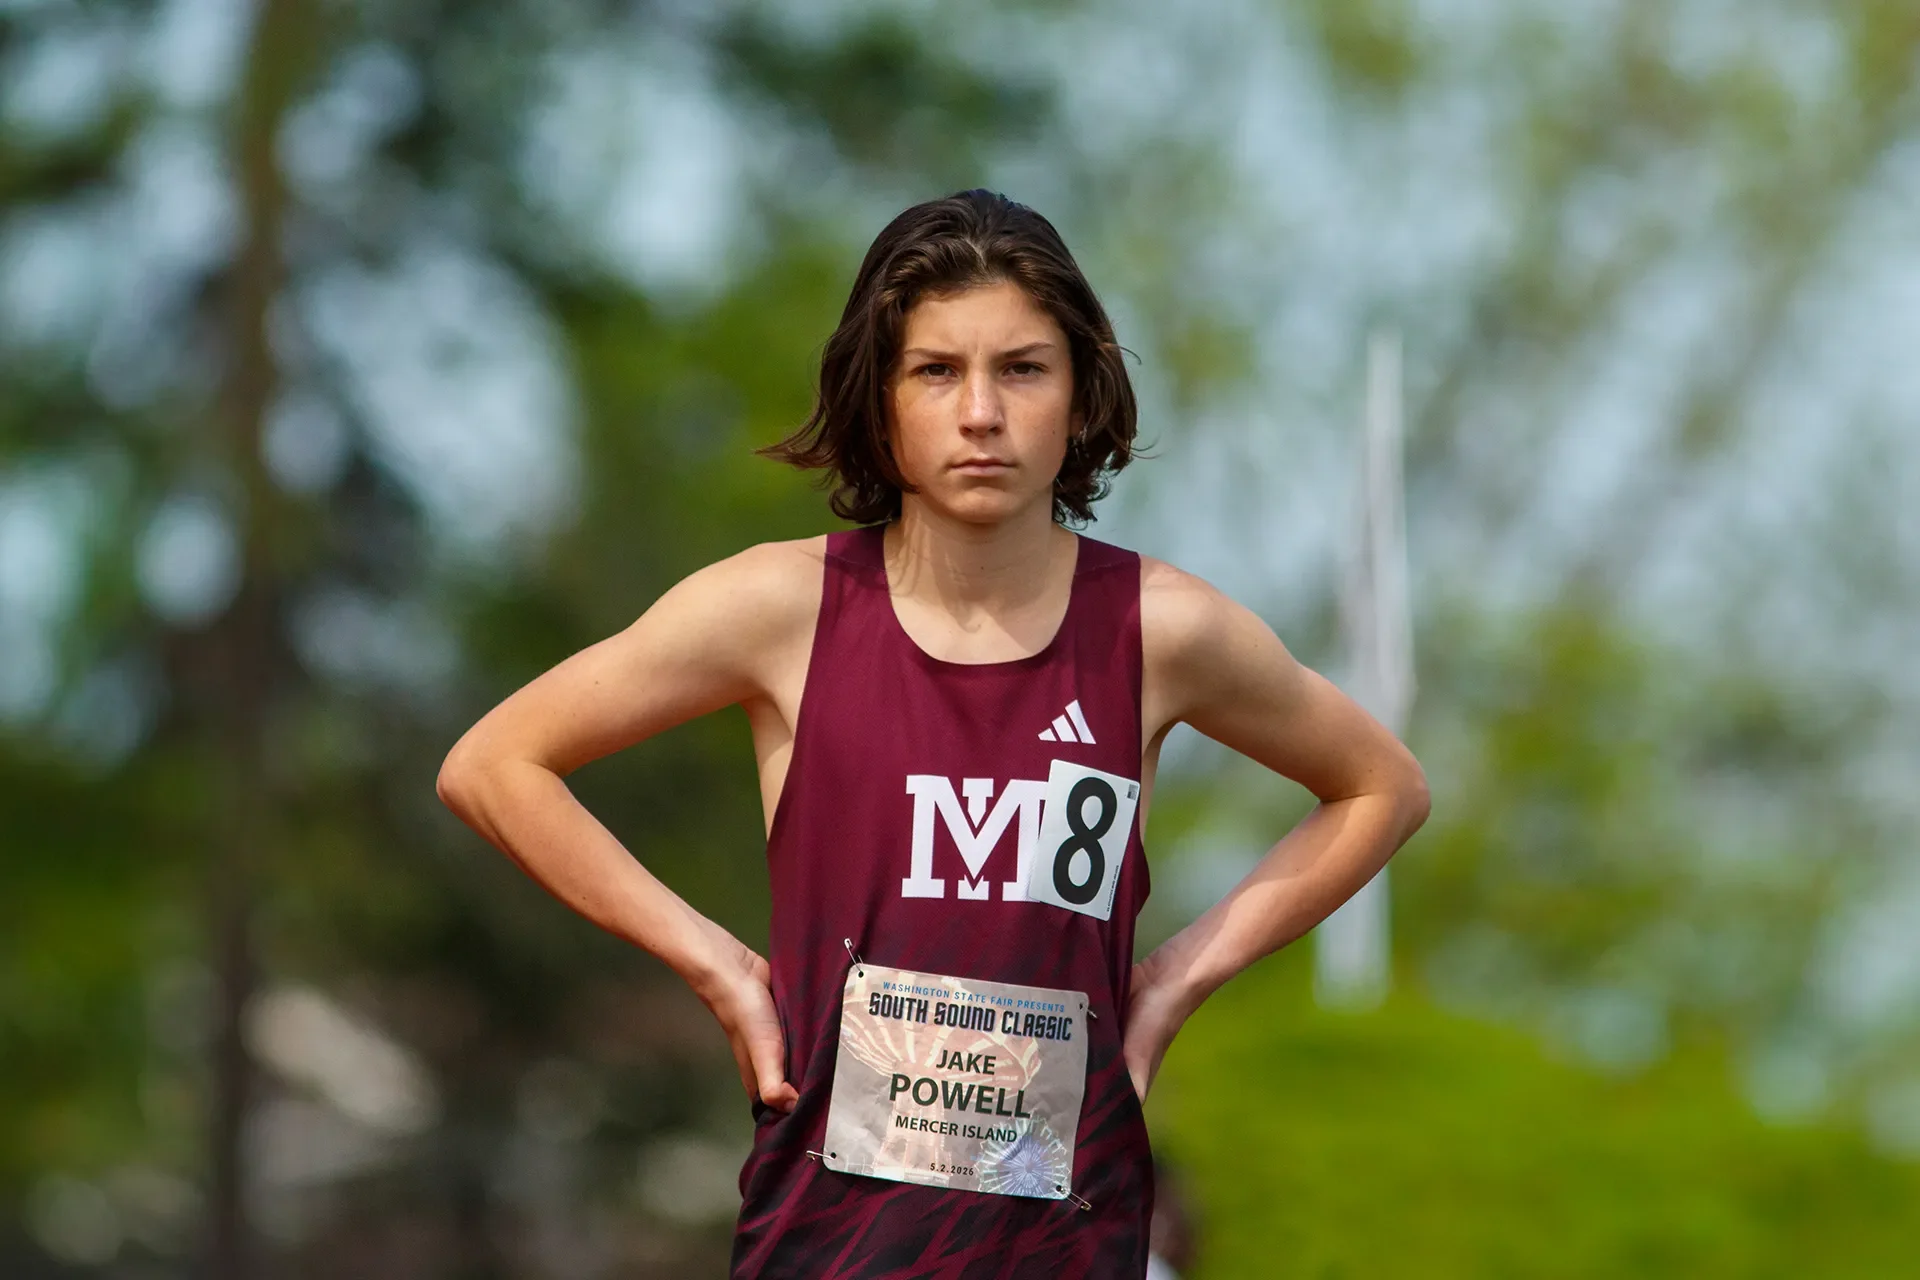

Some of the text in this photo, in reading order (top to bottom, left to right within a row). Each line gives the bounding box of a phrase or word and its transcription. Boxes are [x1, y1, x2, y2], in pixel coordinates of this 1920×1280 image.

[1053, 776, 1118, 905] 8
[883, 981, 1065, 1013] WASHINGTON STATE FAIR PRESENTS
[868, 992, 1073, 1041] SOUTH SOUND CLASSIC
[936, 1049, 997, 1076] JAKE
[889, 1073, 1031, 1119] POWELL
[895, 1115, 1018, 1143] MERCER ISLAND
[930, 1162, 974, 1176] 5.2.2026
